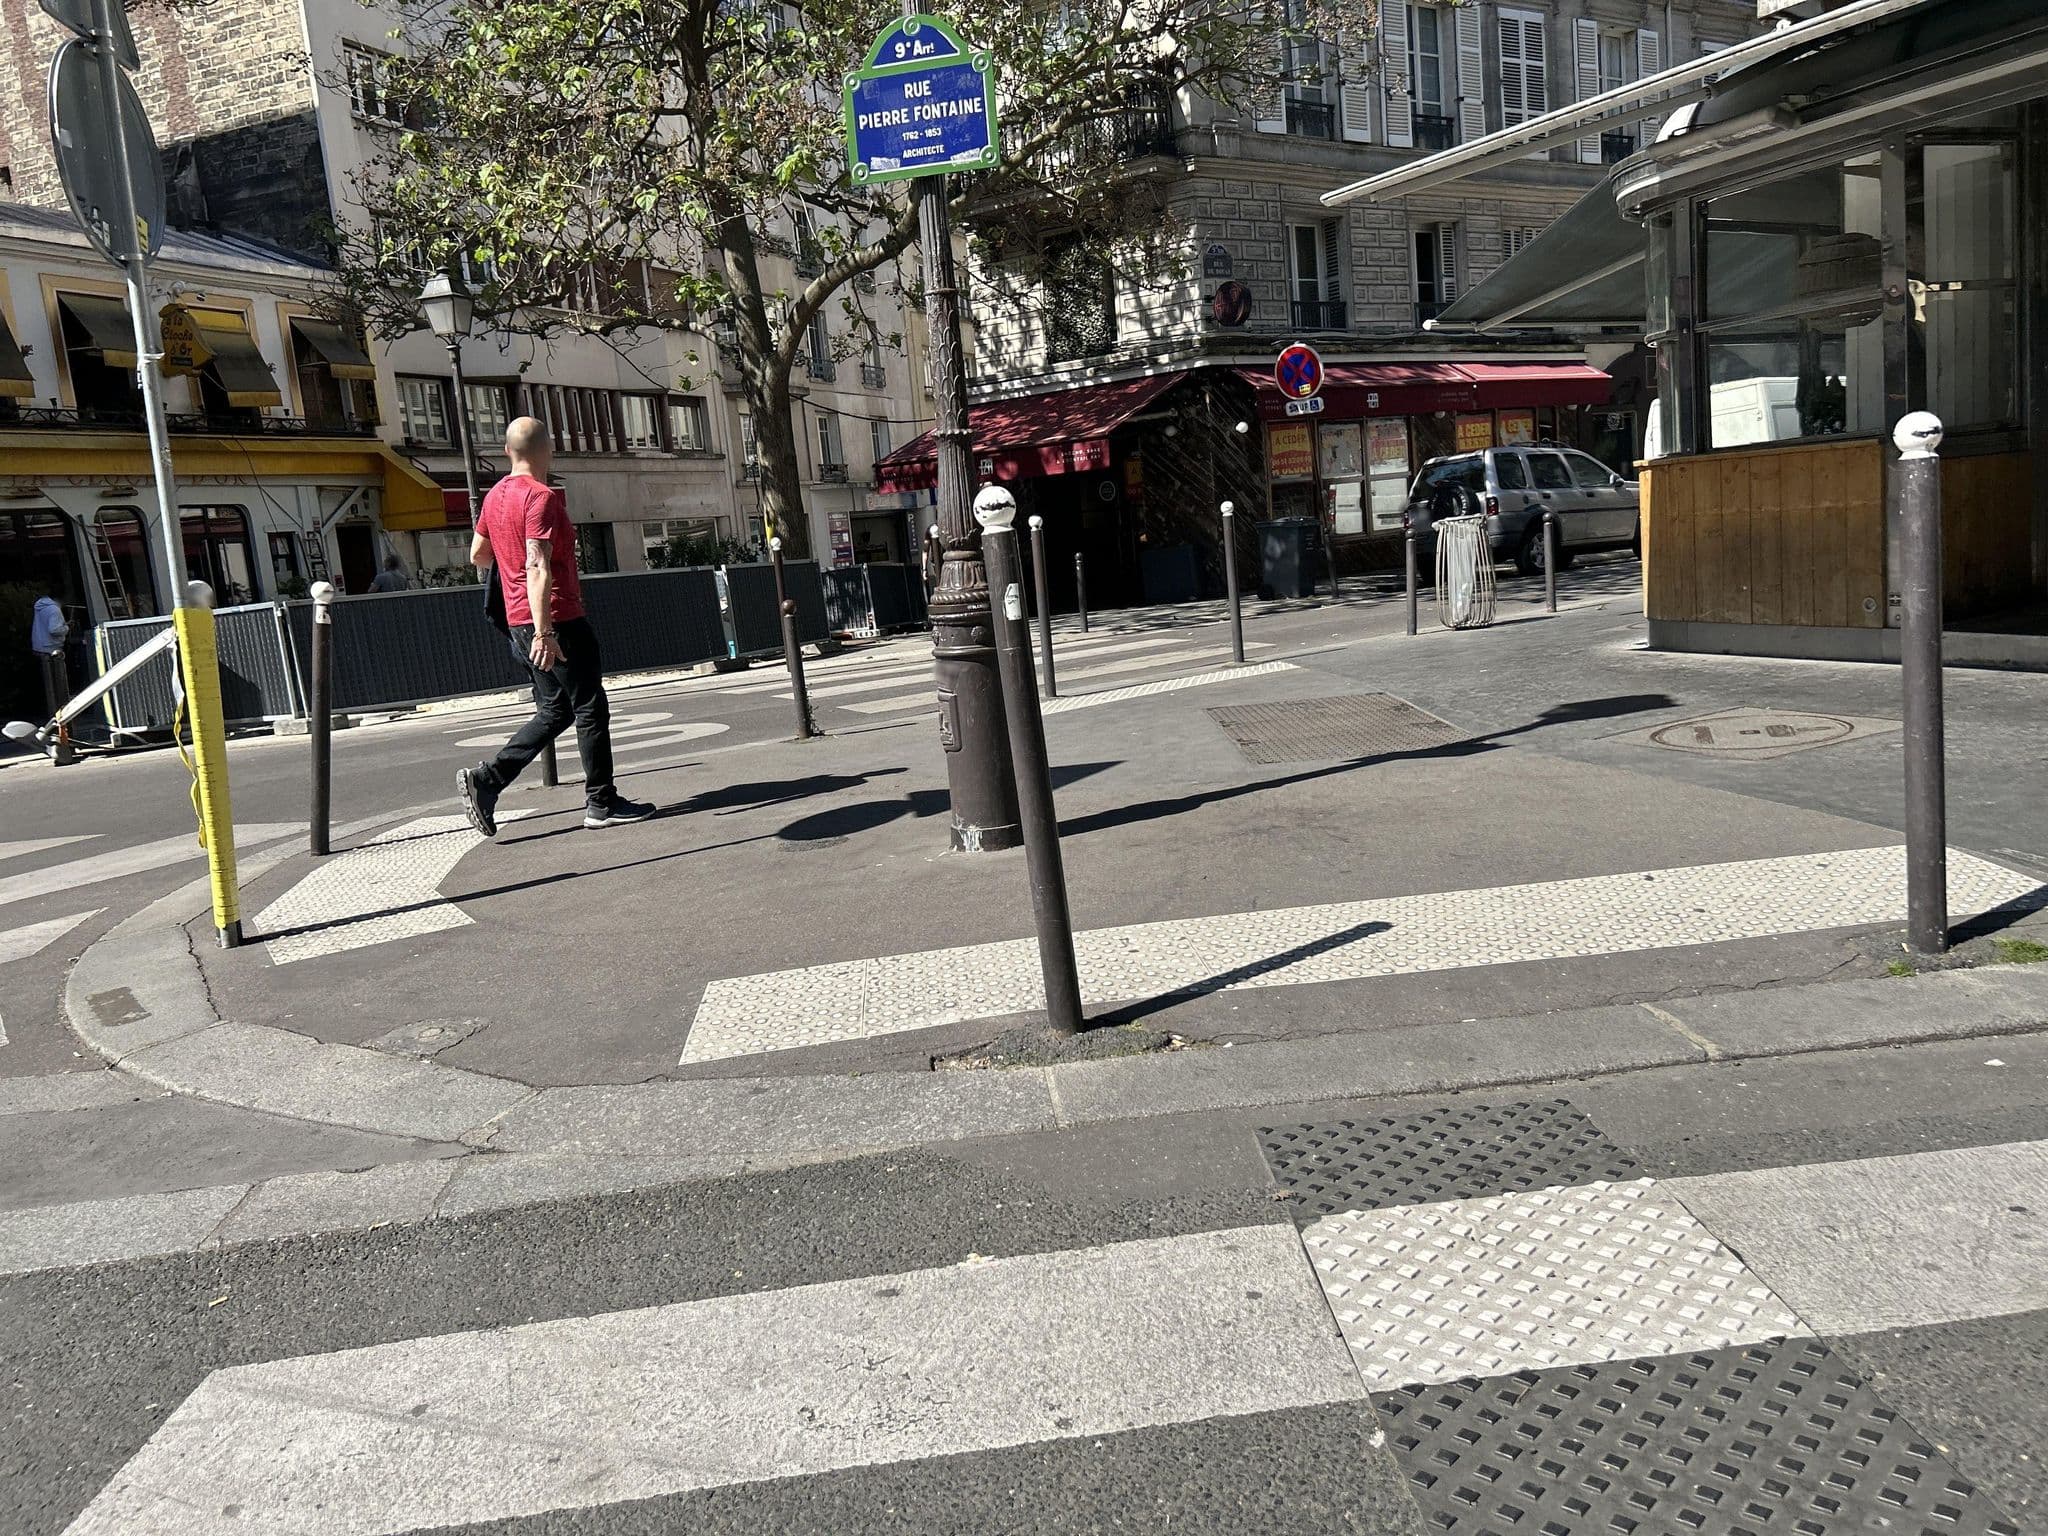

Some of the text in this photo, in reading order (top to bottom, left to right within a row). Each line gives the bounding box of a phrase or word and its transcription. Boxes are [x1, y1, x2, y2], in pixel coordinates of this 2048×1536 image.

[904, 80, 932, 99] RUE
[859, 97, 983, 130] PIERRE FONTAINE
[902, 130, 919, 141] 1762
[903, 145, 945, 158] ARCHITECTE
